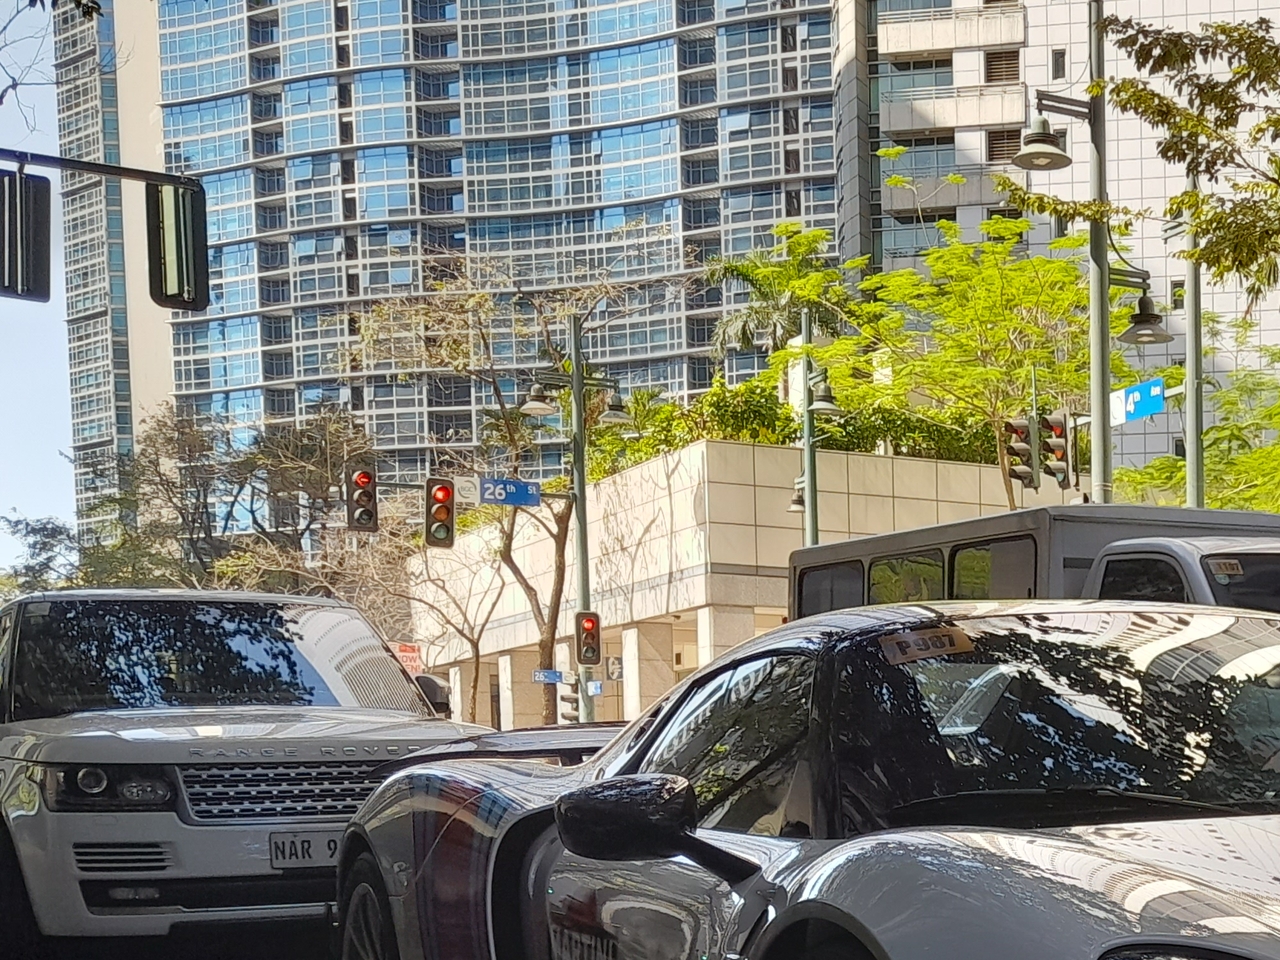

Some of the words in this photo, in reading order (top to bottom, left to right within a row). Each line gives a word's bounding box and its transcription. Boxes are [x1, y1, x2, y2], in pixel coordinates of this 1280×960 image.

[483, 483, 516, 500] 26th
[527, 486, 537, 494] St
[189, 747, 298, 758] RANGE
[274, 839, 312, 860] NAR
[327, 839, 338, 858] 9
